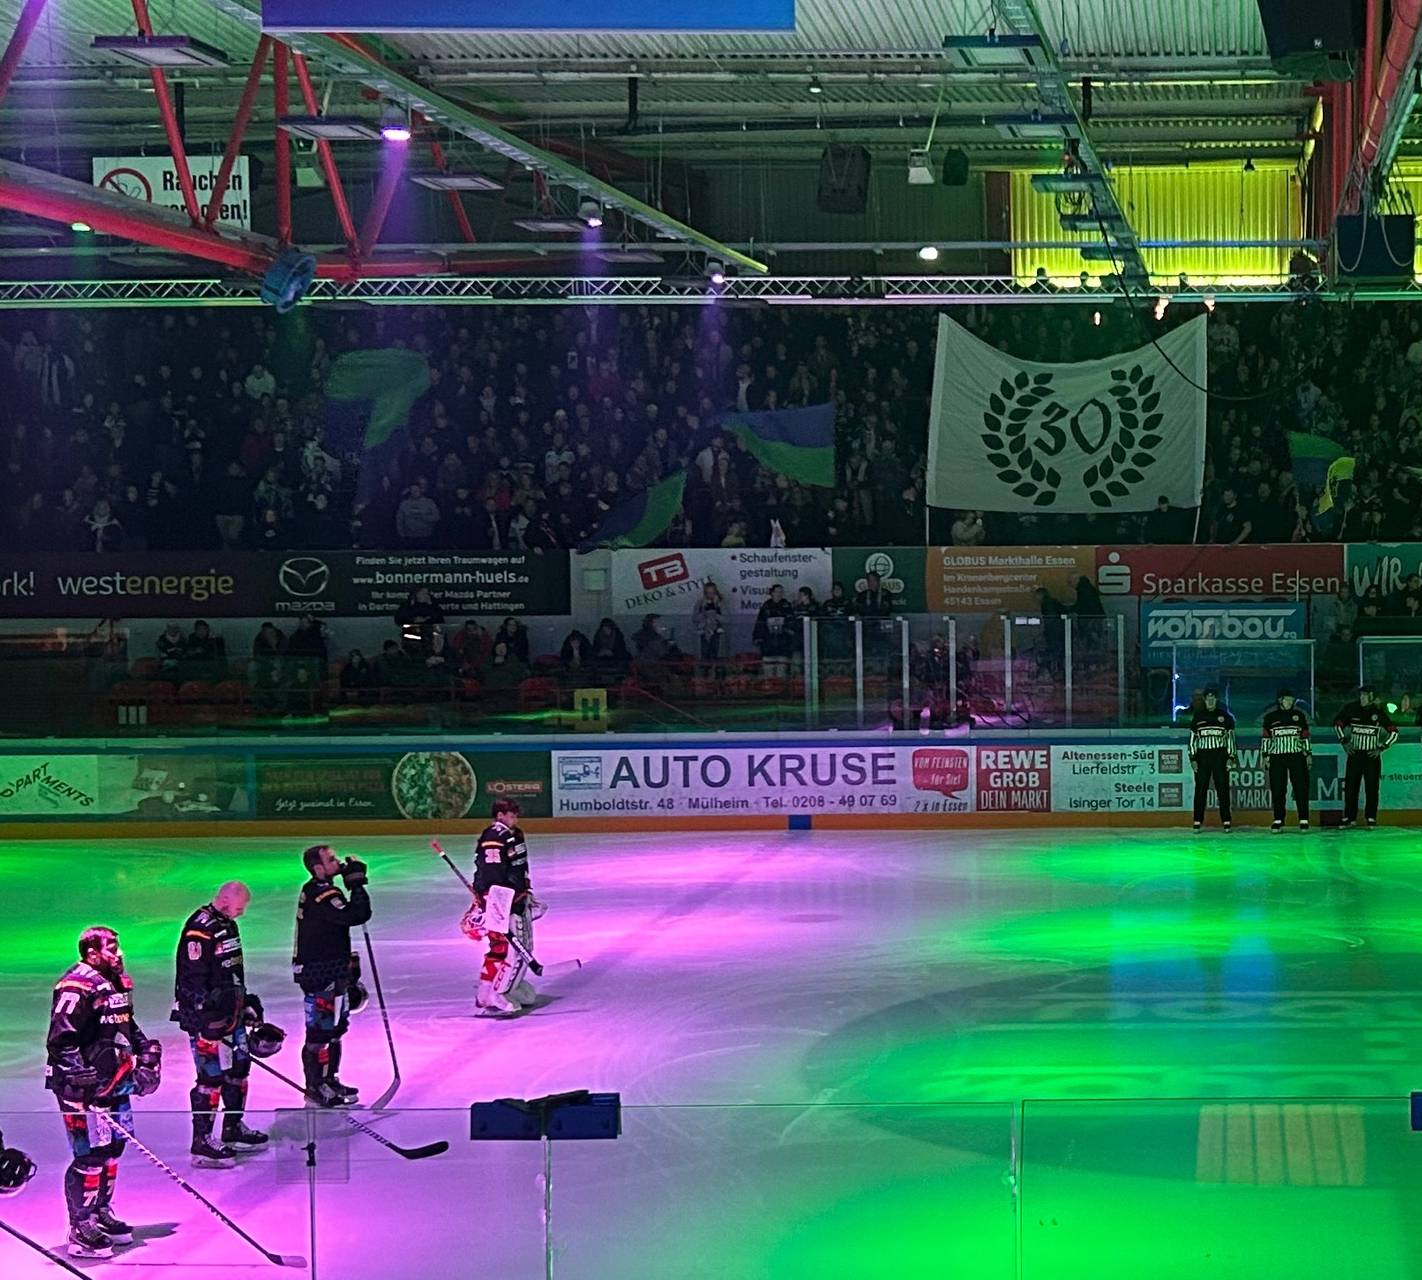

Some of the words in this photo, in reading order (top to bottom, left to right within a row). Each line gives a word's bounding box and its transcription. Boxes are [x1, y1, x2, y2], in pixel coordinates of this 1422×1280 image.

[163, 170, 242, 191] Rchn
[1033, 398, 1112, 456] 30
[739, 552, 816, 563] Schaufenster-
[943, 556, 986, 566] GLOBUS
[1045, 555, 1076, 565] Essen
[739, 568, 799, 580] gestaltung
[0, 570, 35, 596] rk!
[57, 568, 234, 601] westenergie
[740, 585, 770, 595] Visu
[1143, 572, 1263, 595] Sparkasse
[1272, 572, 1340, 593] Essen
[624, 590, 662, 609] DEKO
[980, 750, 1048, 769] REWE
[1062, 750, 1155, 761] Altenessen-Süd
[609, 755, 732, 789] AUTO
[747, 752, 897, 787] KRUSE
[1149, 763, 1156, 775] 3
[989, 771, 1040, 788] GROB
[1229, 770, 1265, 787] ROB
[1114, 783, 1154, 793] Steele
[656, 797, 674, 810] 48
[688, 796, 749, 810] Mülheim
[792, 795, 825, 808] 0208
[859, 794, 876, 807] 07
[980, 790, 1007, 810] DEIN
[1011, 790, 1048, 809] MARKT
[1069, 797, 1111, 810] Isinger
[1115, 797, 1136, 809] Tor
[1140, 796, 1155, 808] 14
